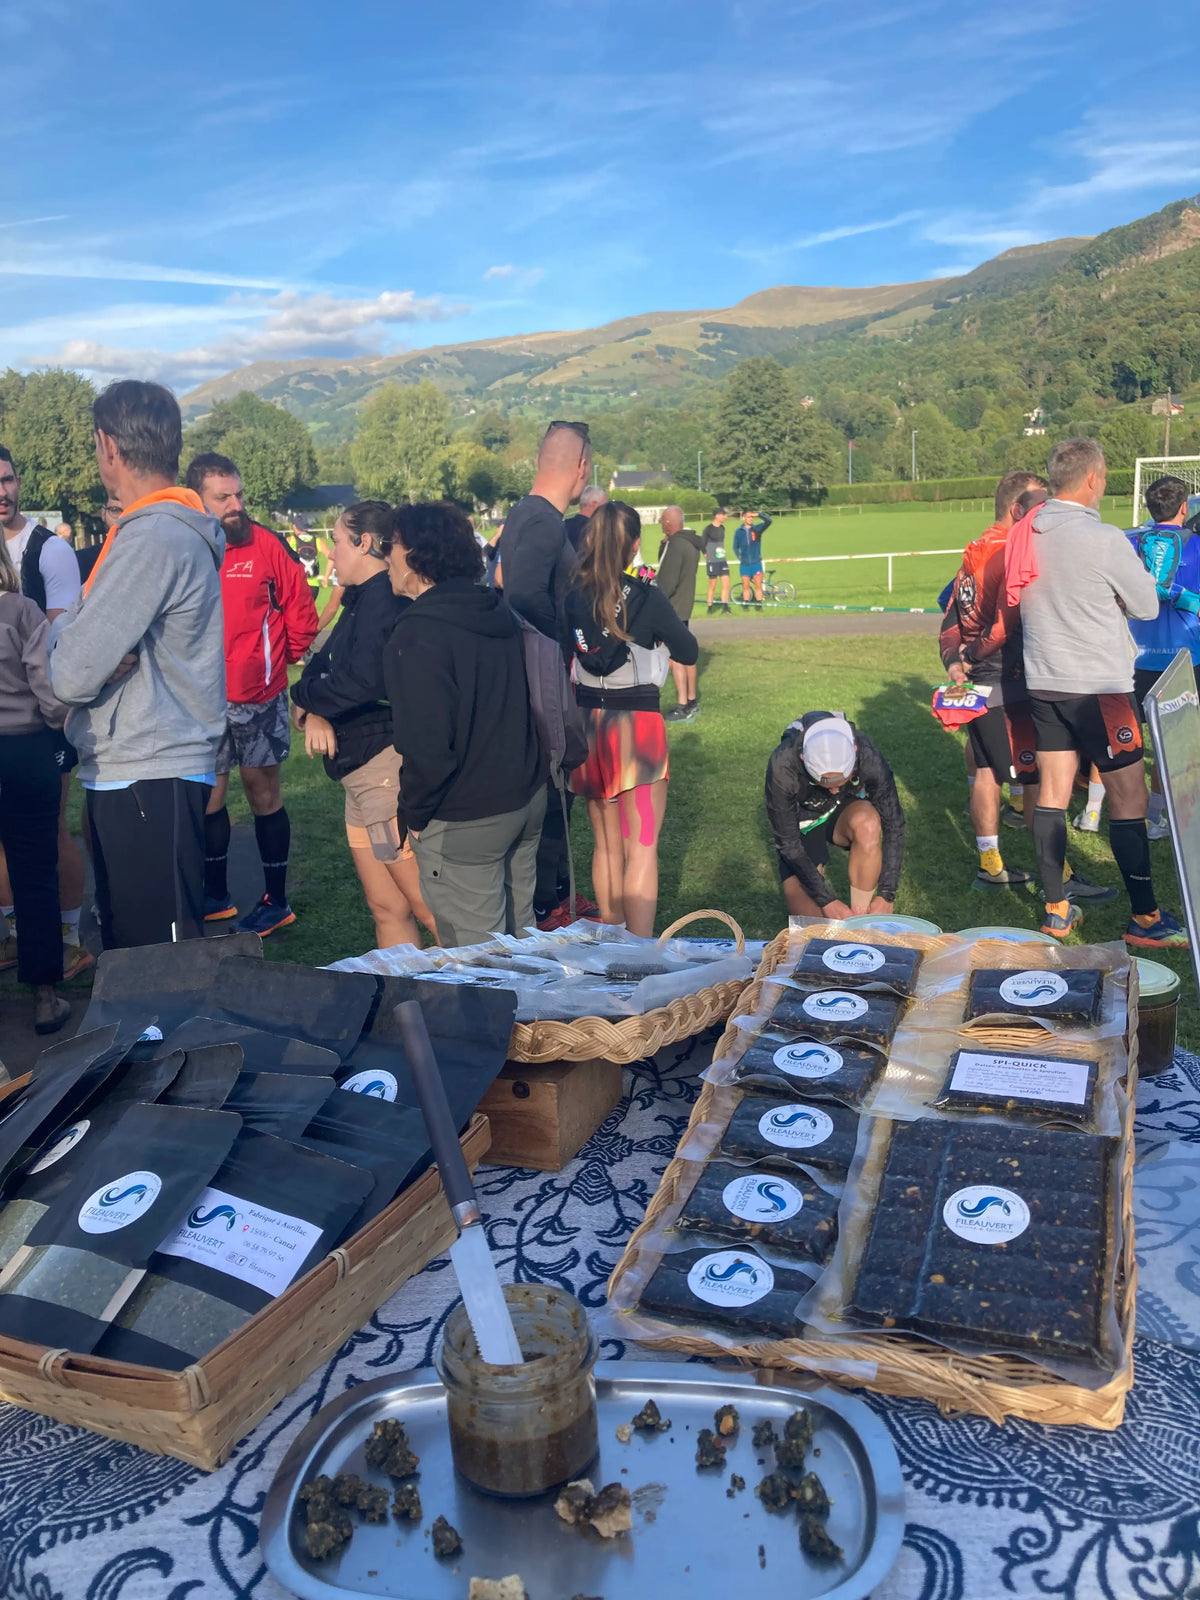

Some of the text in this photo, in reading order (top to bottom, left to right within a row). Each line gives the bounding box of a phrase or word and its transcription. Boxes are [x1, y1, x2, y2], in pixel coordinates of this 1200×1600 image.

[833, 959, 876, 968] FILEAUVERT
[812, 1006, 857, 1015] FILEAUVERT
[782, 1059, 829, 1072] FILEAUVERT
[993, 1059, 1048, 1069] SPI-QUICK
[766, 1126, 817, 1140] FILEAUVERT
[736, 1178, 758, 1212] FILEAUVERT
[86, 1206, 132, 1221] FILEAUVERT
[248, 1209, 276, 1223] Fabriqué
[281, 1222, 307, 1237] Aurillac
[955, 1218, 1014, 1230] FILEAUVERT
[177, 1228, 225, 1249] FILEAUVERT
[273, 1235, 297, 1250] Cantal
[700, 1279, 755, 1296] FILEAUVERT
